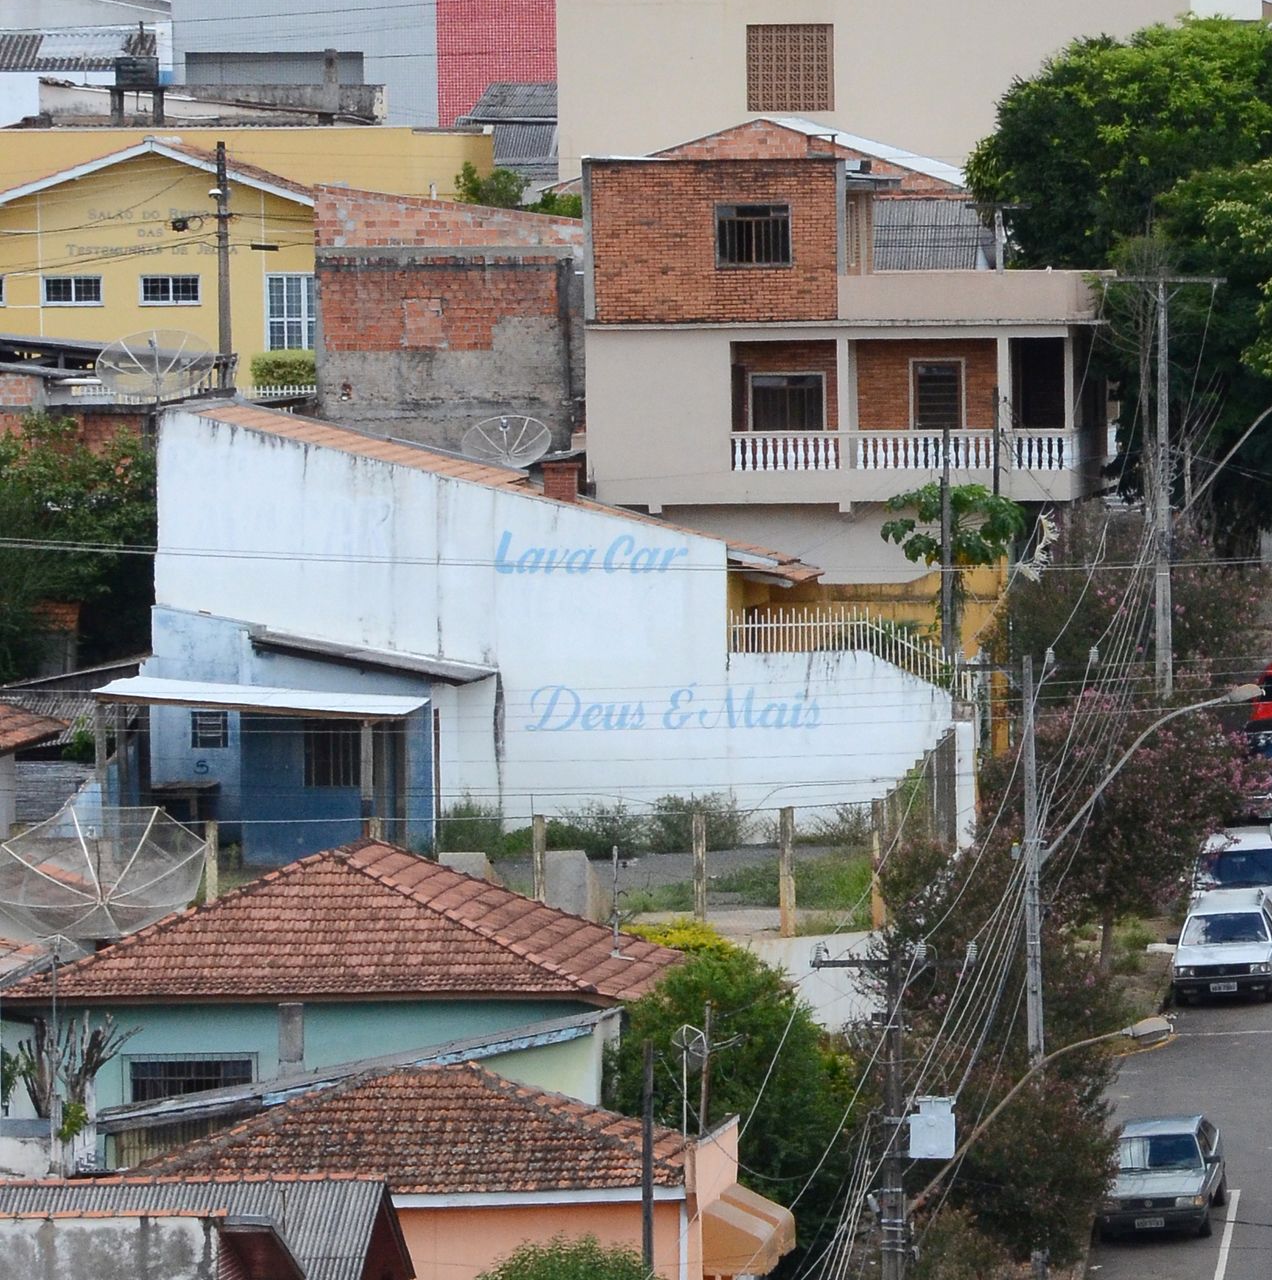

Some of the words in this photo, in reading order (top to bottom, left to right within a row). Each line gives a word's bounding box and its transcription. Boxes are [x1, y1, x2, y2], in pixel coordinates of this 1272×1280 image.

[494, 530, 596, 574] Lava
[601, 534, 689, 574] Car
[524, 685, 646, 732] Deus
[697, 686, 821, 730] Mais
